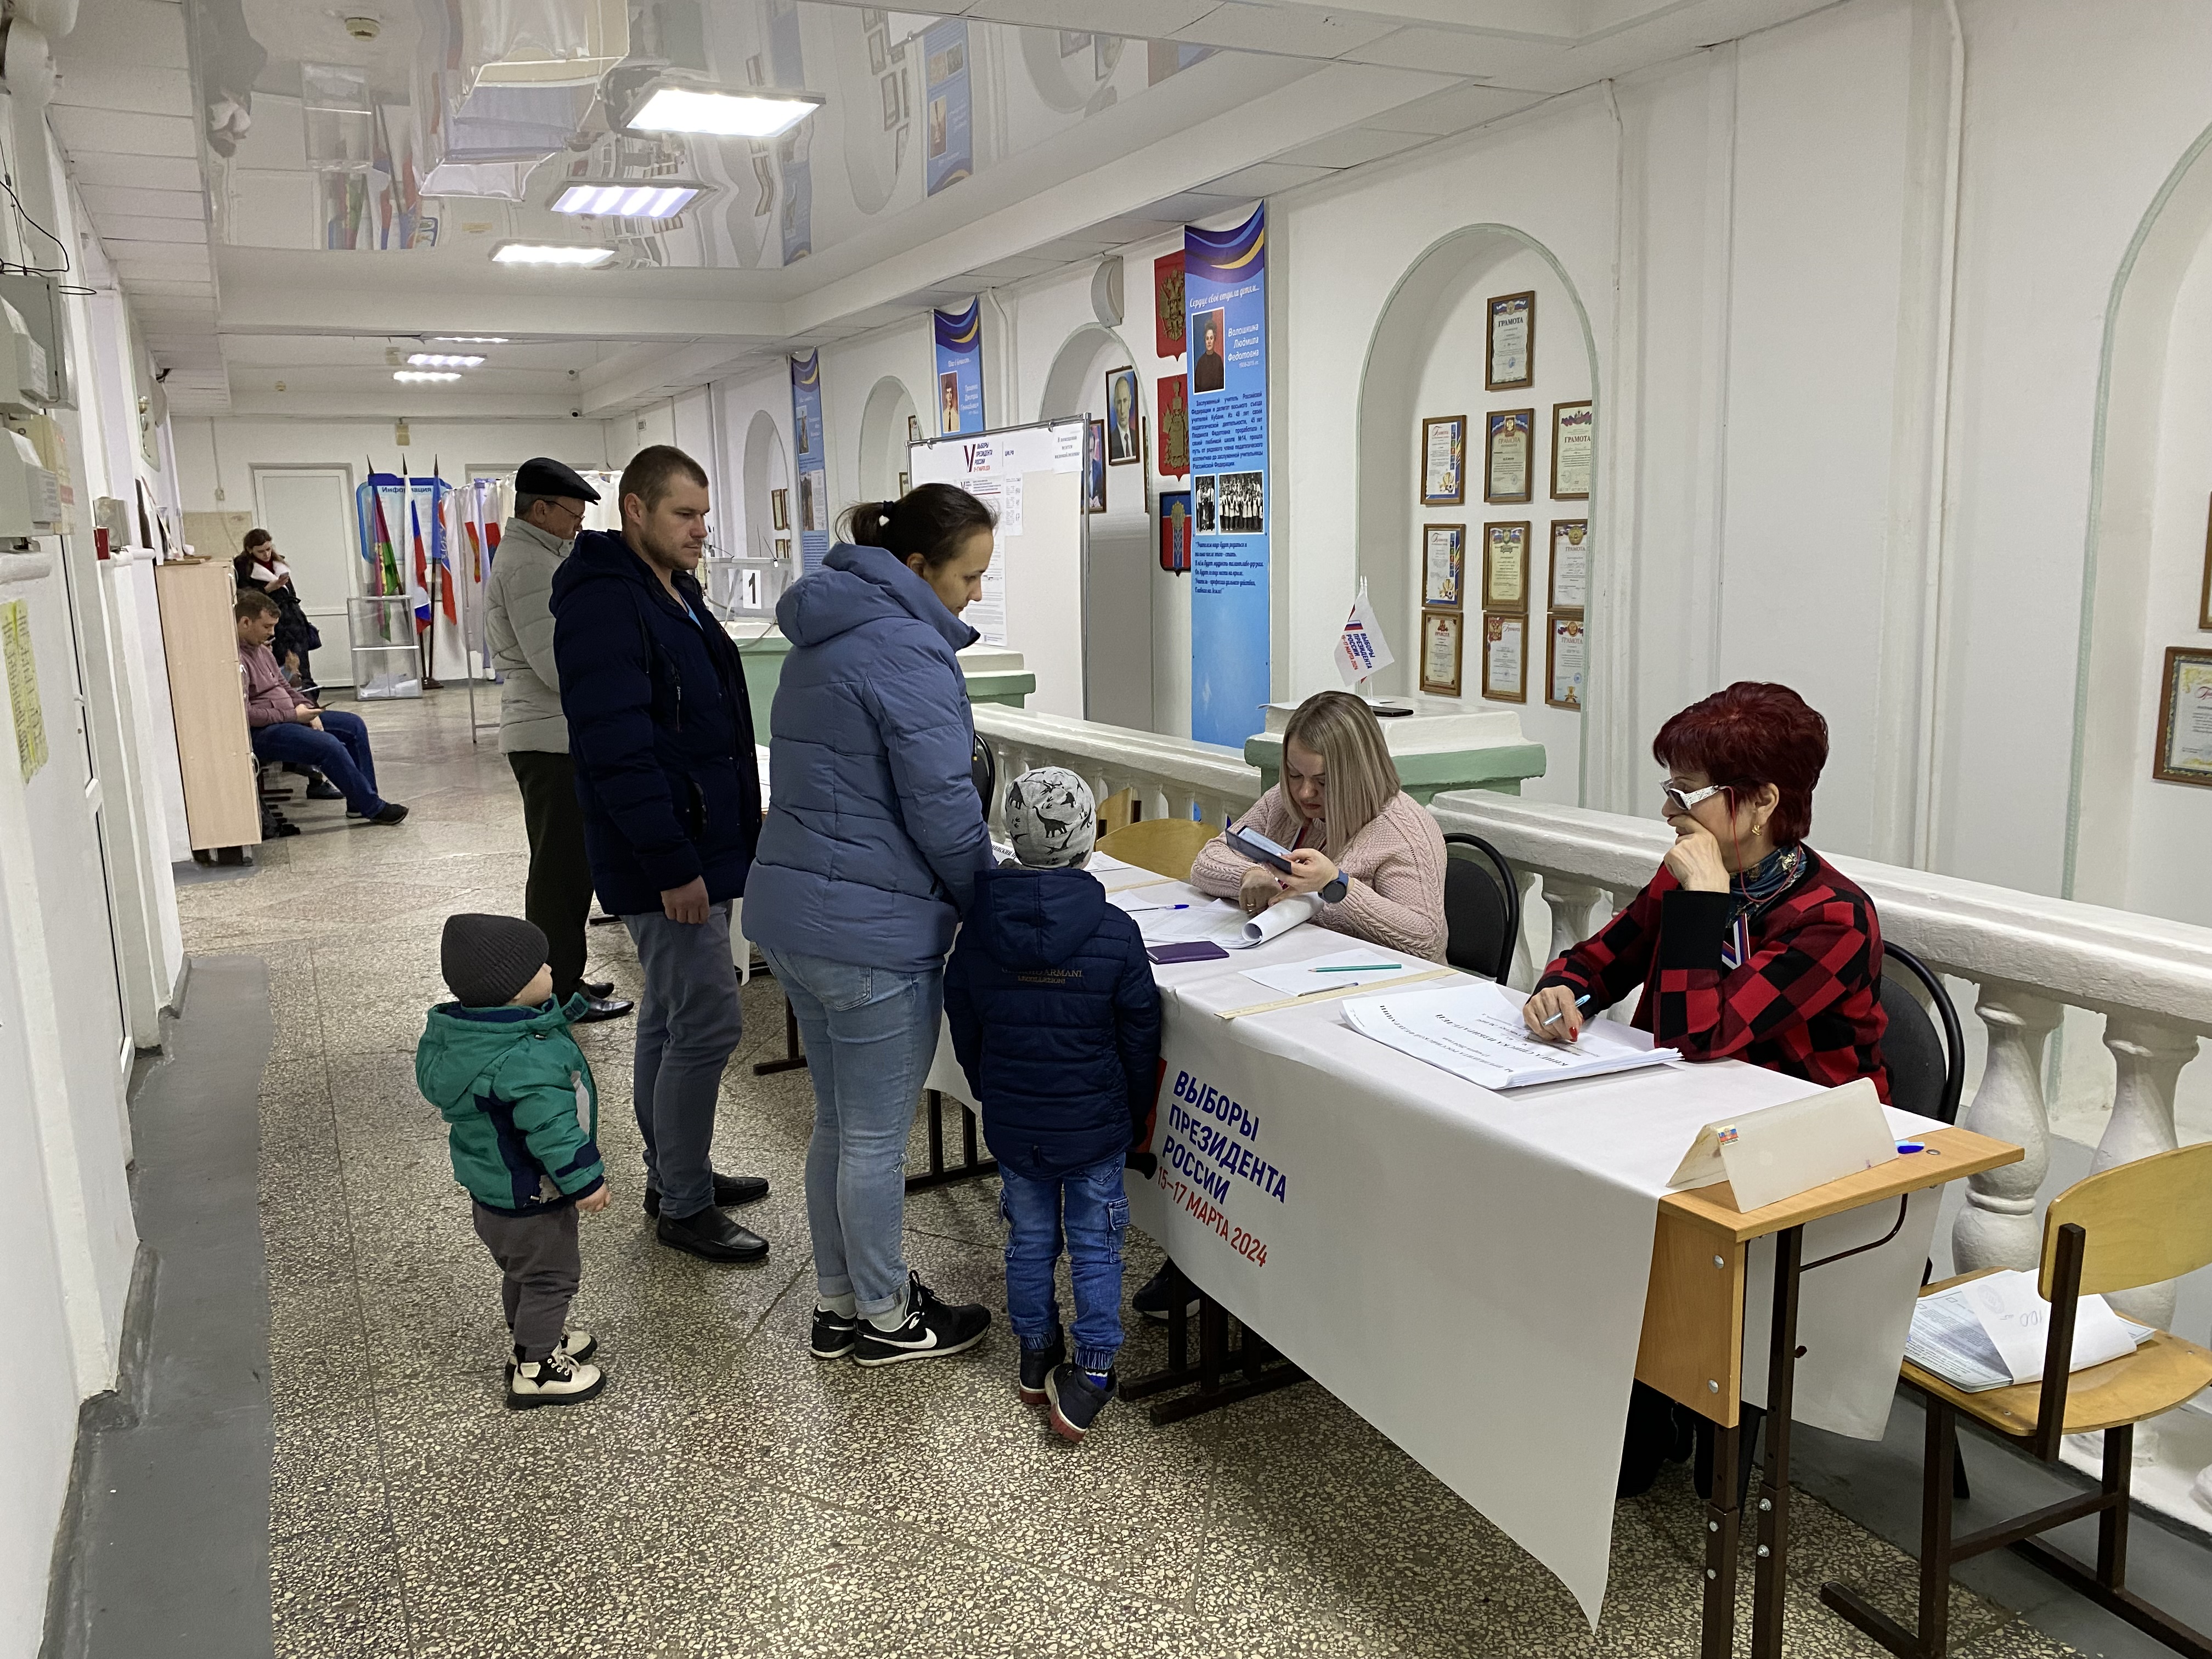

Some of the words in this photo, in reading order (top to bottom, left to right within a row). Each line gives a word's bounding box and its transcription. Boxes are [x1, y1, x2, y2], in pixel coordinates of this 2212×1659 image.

[1498, 317, 1523, 328] ГРАМОТА
[1234, 336, 1259, 349] Людмила
[1228, 349, 1259, 362] Федотовна
[1498, 437, 1521, 445] ГРАМОТА
[382, 486, 432, 494] Инфорация
[748, 573, 756, 604] 1
[1345, 645, 1355, 660] МАРТА
[1346, 634, 1360, 657] РОССИИ
[1353, 634, 1372, 669] ПРЕЗИДЕНТА
[1361, 633, 1375, 658] ВЫБОРЫ
[1380, 1005, 1415, 1035] ФЕДЕРАЦИИ
[1435, 1014, 1496, 1042] ИЗБИРАТЕЛЕЙ
[1497, 1041, 1534, 1054] СПИСКА
[1535, 1053, 1569, 1066] КНИГА
[1173, 1070, 1259, 1142] ВЫБОРЫ
[1169, 1103, 1287, 1204] ПРЕЗИДЕНТА
[1162, 1135, 1231, 1205] РОССИИ
[1185, 1191, 1229, 1242] МАРТА
[1230, 1227, 1268, 1268] 2024
